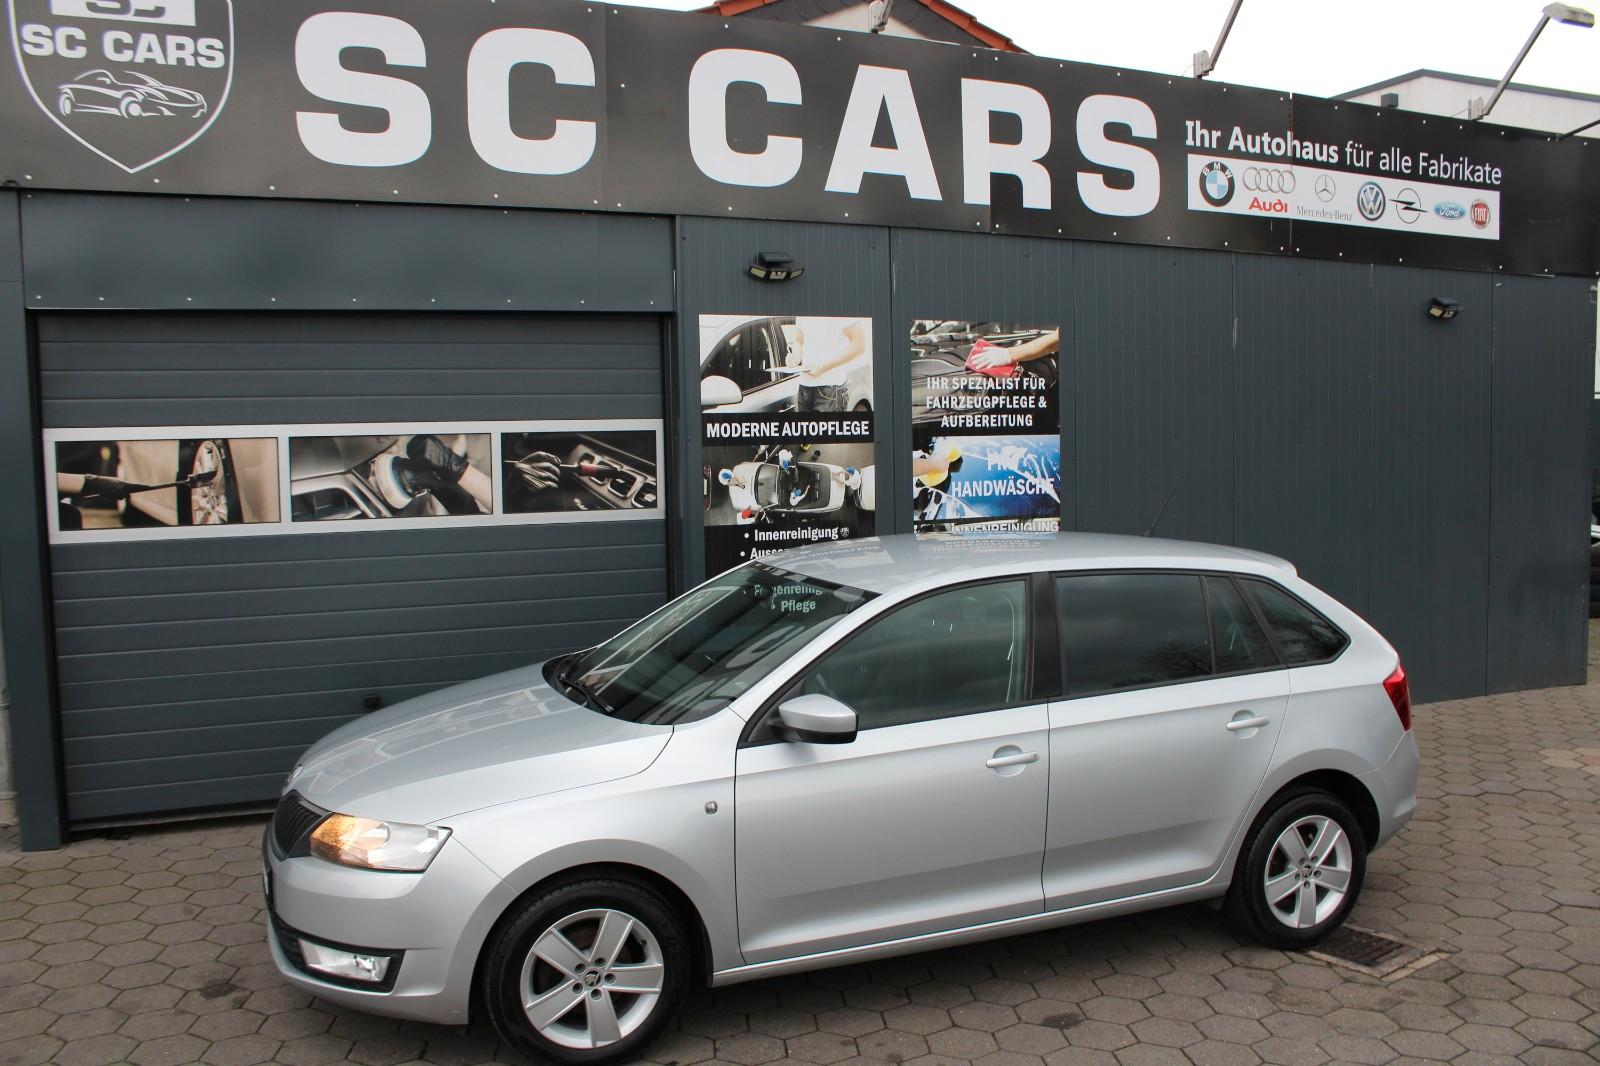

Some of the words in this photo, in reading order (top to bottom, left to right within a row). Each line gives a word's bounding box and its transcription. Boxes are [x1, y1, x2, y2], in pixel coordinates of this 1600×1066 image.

[21, 23, 88, 59] SC
[103, 30, 225, 69] CARS
[295, 11, 598, 175] SC
[688, 48, 1161, 217] CARS
[1185, 119, 1221, 150] Ihr
[1228, 126, 1339, 164] Autohaus
[1345, 140, 1374, 168] für
[1380, 147, 1412, 174] alle
[1419, 151, 1502, 186] Fabrikate
[1202, 161, 1234, 180] BMW
[1249, 196, 1288, 213] Audi
[1439, 204, 1461, 218] Ford
[1296, 205, 1353, 221] Mercedes-Benz
[1474, 207, 1488, 222] FIAT
[926, 377, 949, 390] IHR
[951, 376, 1021, 390] SPEZIALIST
[1023, 374, 1046, 390] FÜR
[926, 395, 1036, 409] FAHRZEUGPFLEGE
[1038, 395, 1047, 409] &
[940, 413, 1033, 428] AUFBEREITUNG
[706, 422, 780, 438] MODERNE
[782, 420, 870, 436] AUTOPFLEGE
[754, 526, 839, 541] Innenreinigung
[781, 599, 816, 613] Pflege
